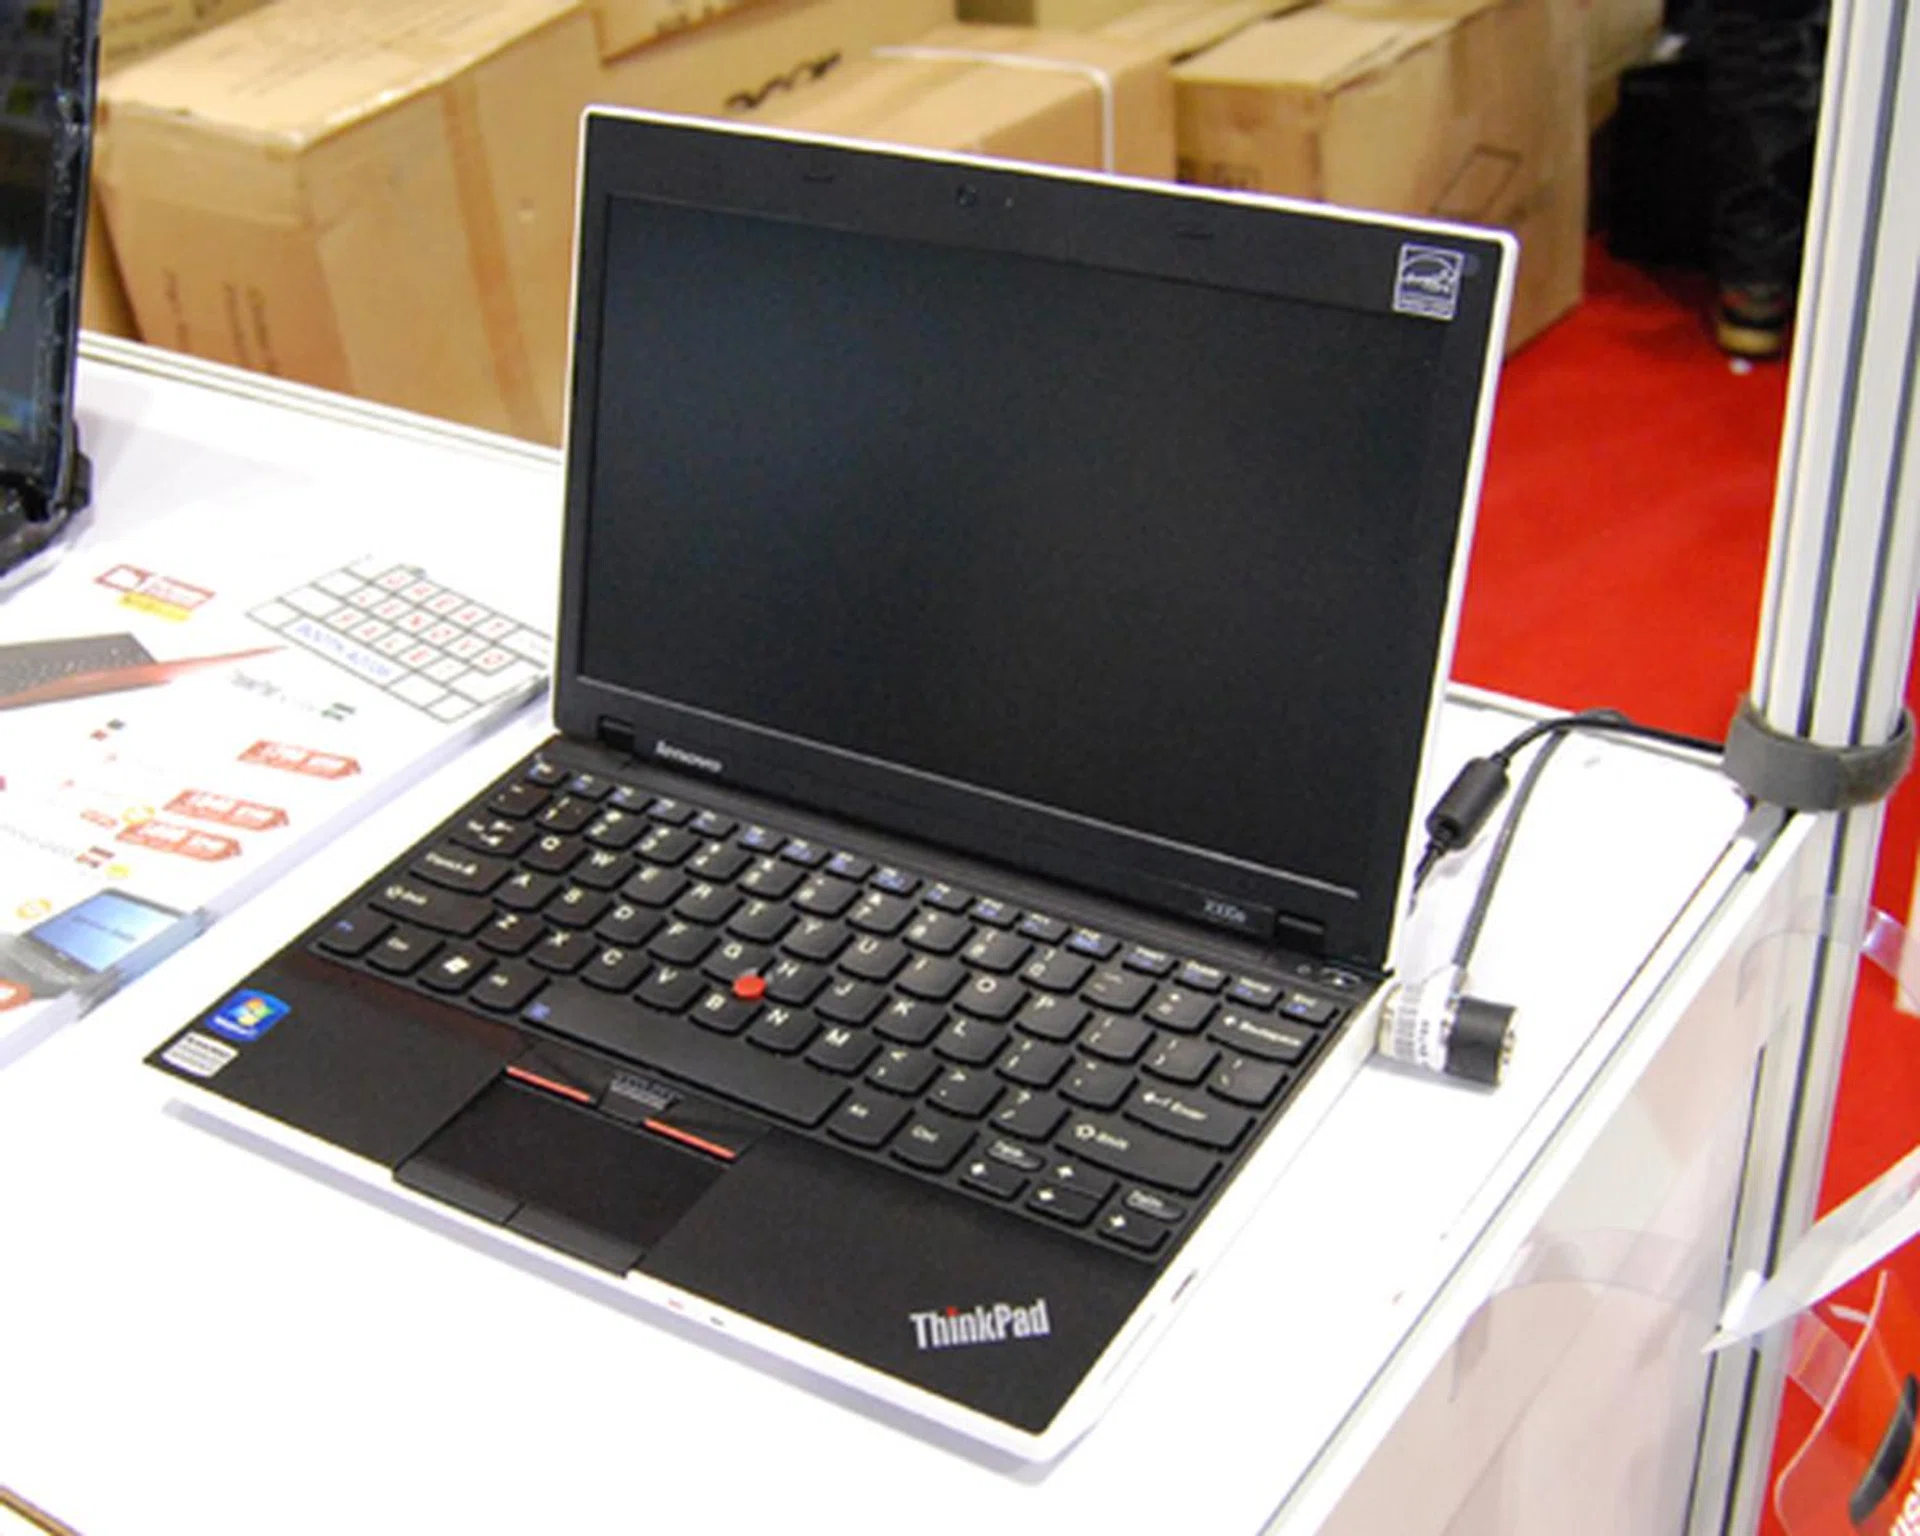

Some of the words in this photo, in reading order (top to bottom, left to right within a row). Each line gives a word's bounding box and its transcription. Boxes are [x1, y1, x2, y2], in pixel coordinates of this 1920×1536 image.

[655, 740, 723, 774] lenovo
[857, 938, 879, 955] U
[975, 976, 998, 994] O
[602, 948, 624, 967] C
[658, 966, 679, 985] V
[704, 993, 726, 1012] B
[765, 1007, 790, 1027] N
[824, 1028, 851, 1048] M
[776, 960, 800, 978] H
[832, 981, 854, 998] J
[953, 1018, 967, 1037] L
[909, 1297, 1051, 1350] ThinkPad
